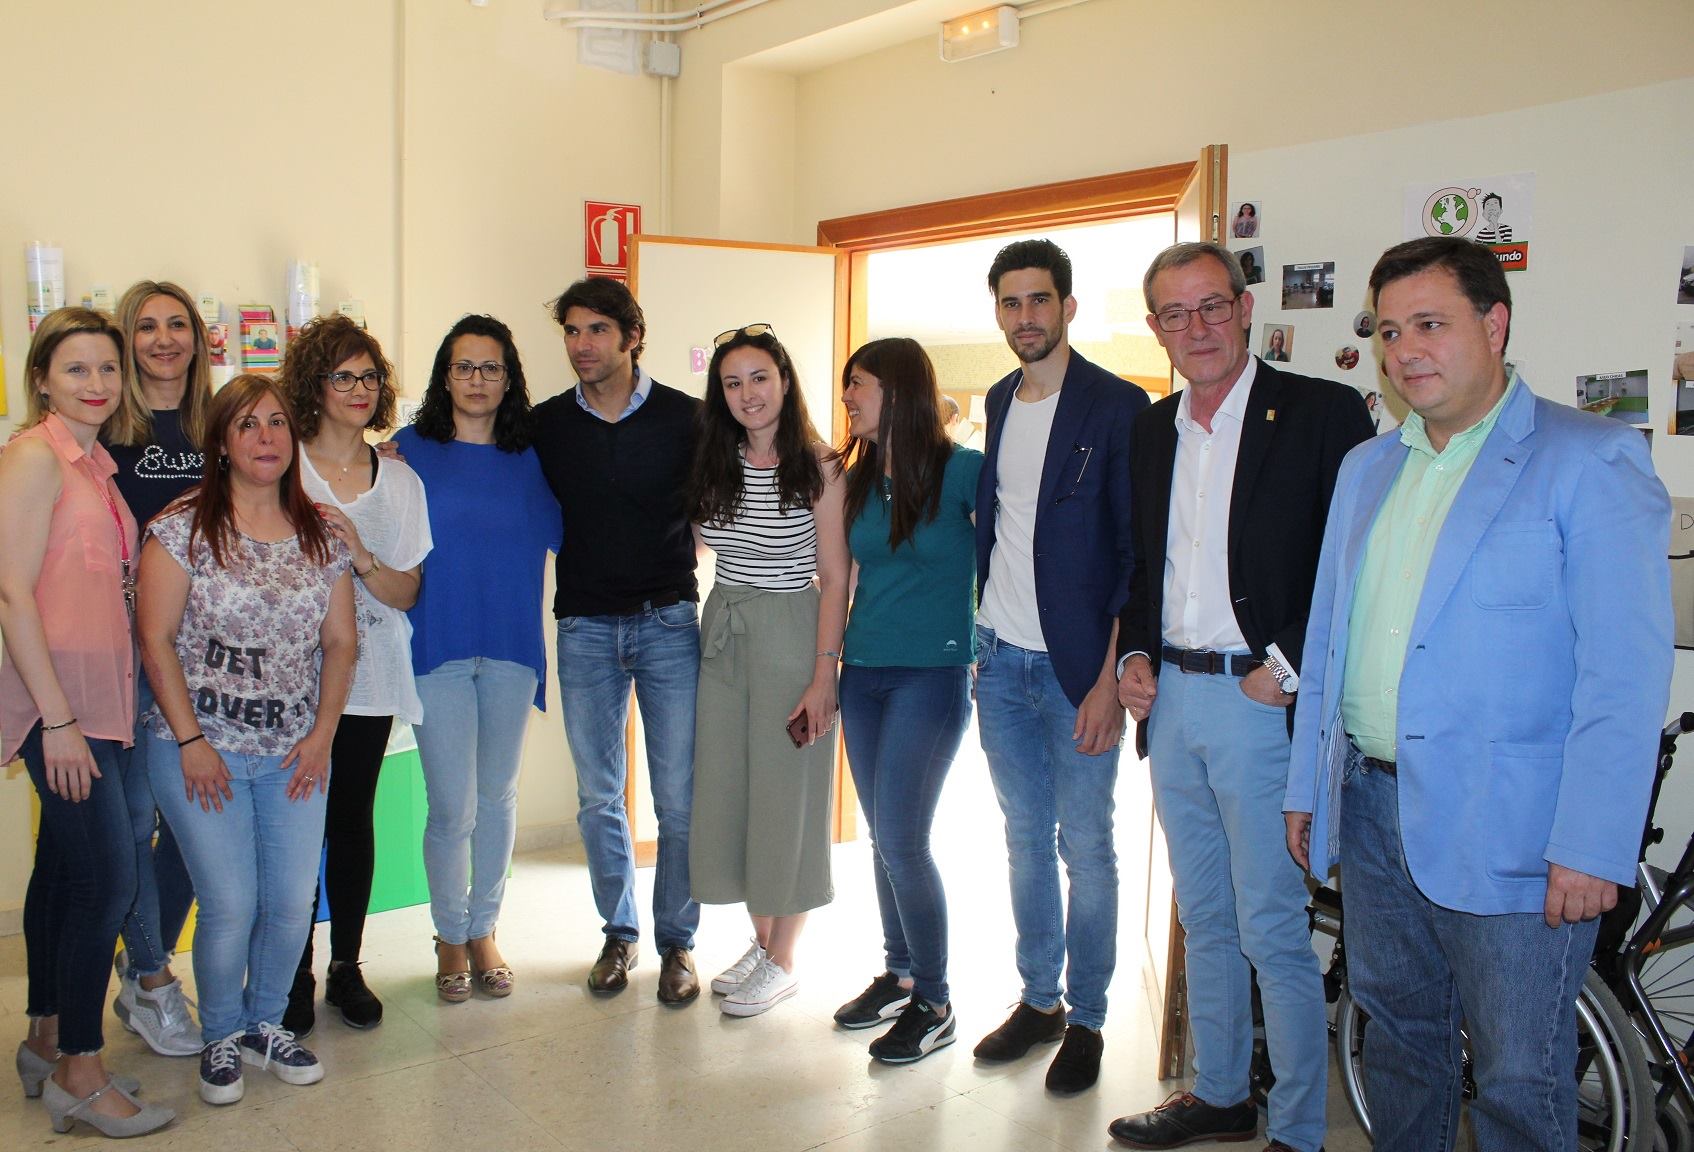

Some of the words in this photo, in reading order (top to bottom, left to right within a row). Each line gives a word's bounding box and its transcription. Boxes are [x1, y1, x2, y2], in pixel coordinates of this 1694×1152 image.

[1494, 250, 1522, 262] undo
[205, 638, 267, 681] GET
[197, 686, 285, 728] OVER
